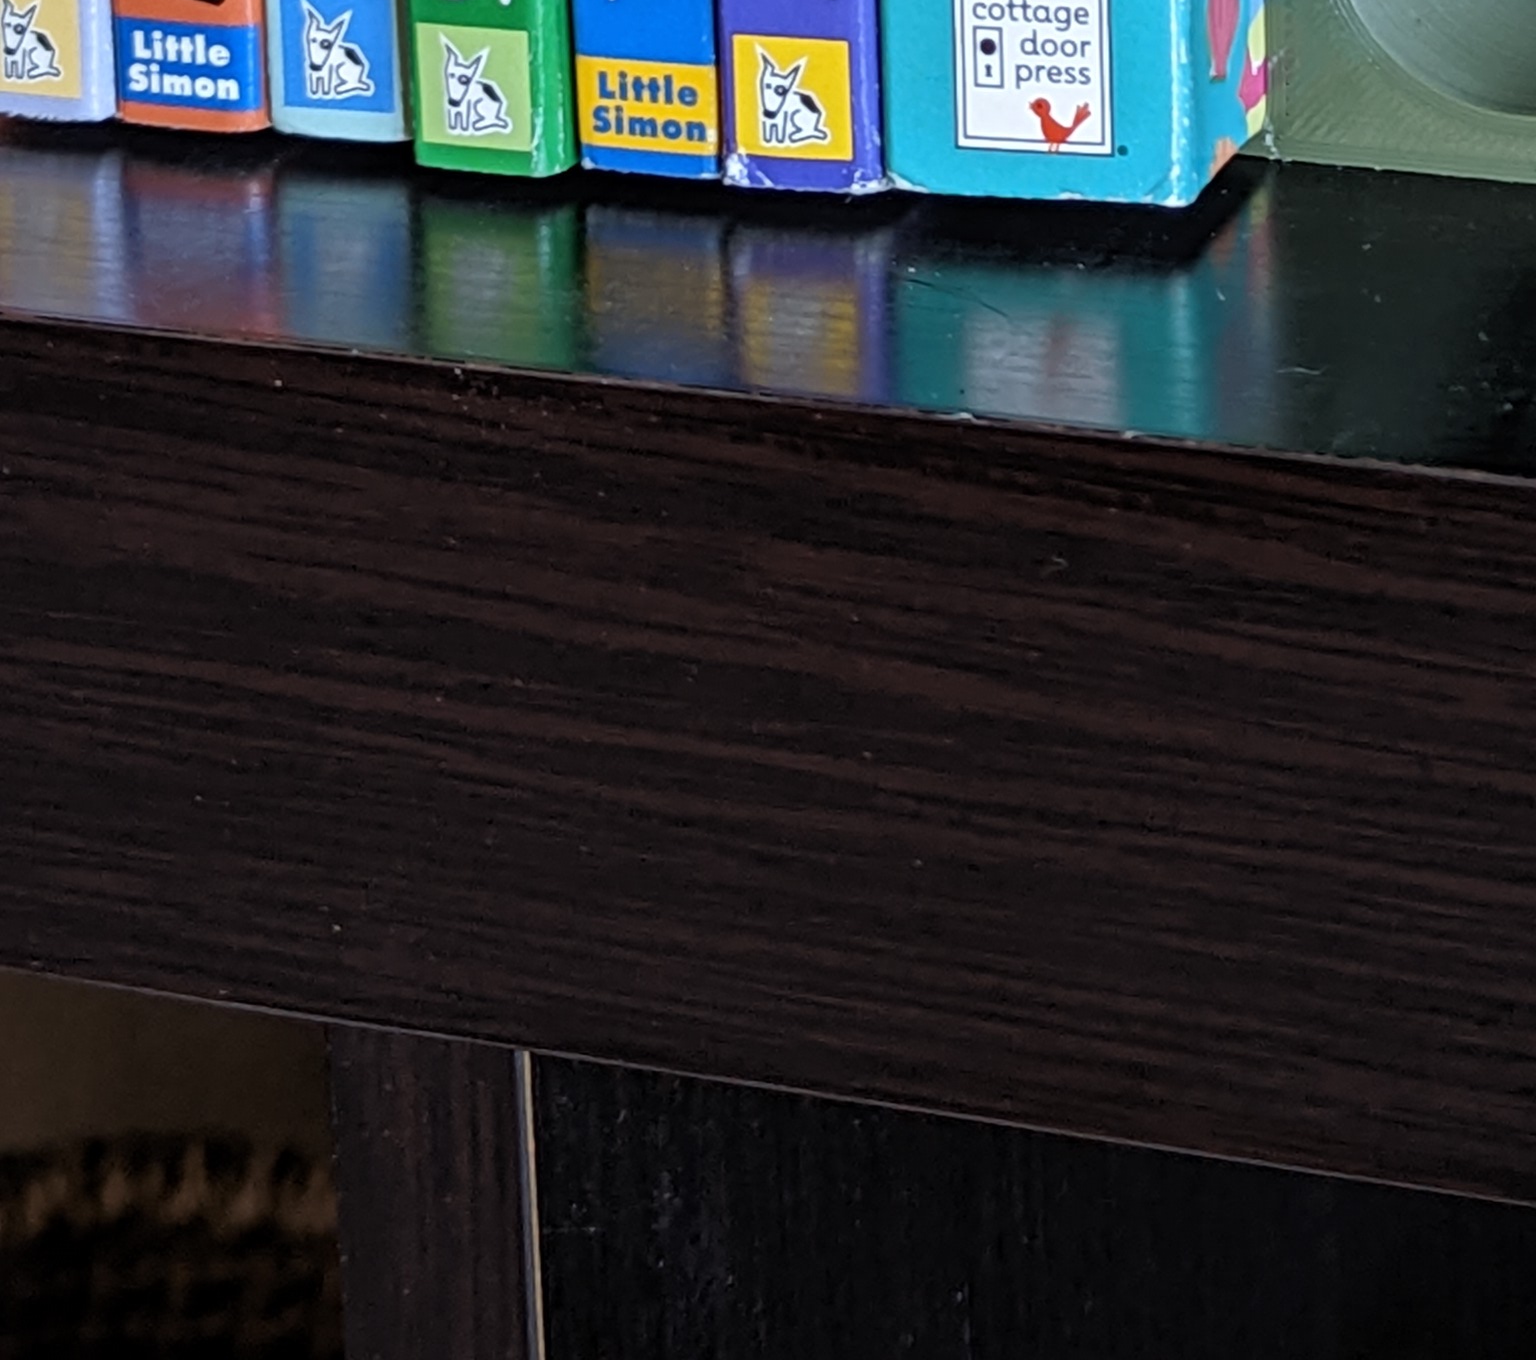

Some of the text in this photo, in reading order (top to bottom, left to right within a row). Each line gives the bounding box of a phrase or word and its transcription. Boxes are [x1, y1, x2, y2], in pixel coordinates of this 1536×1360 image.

[133, 30, 231, 67] Little
[1019, 29, 1092, 58] door
[128, 62, 240, 100] Simon
[598, 70, 698, 107] Little
[1015, 63, 1092, 90] press
[592, 105, 707, 142] Simon
